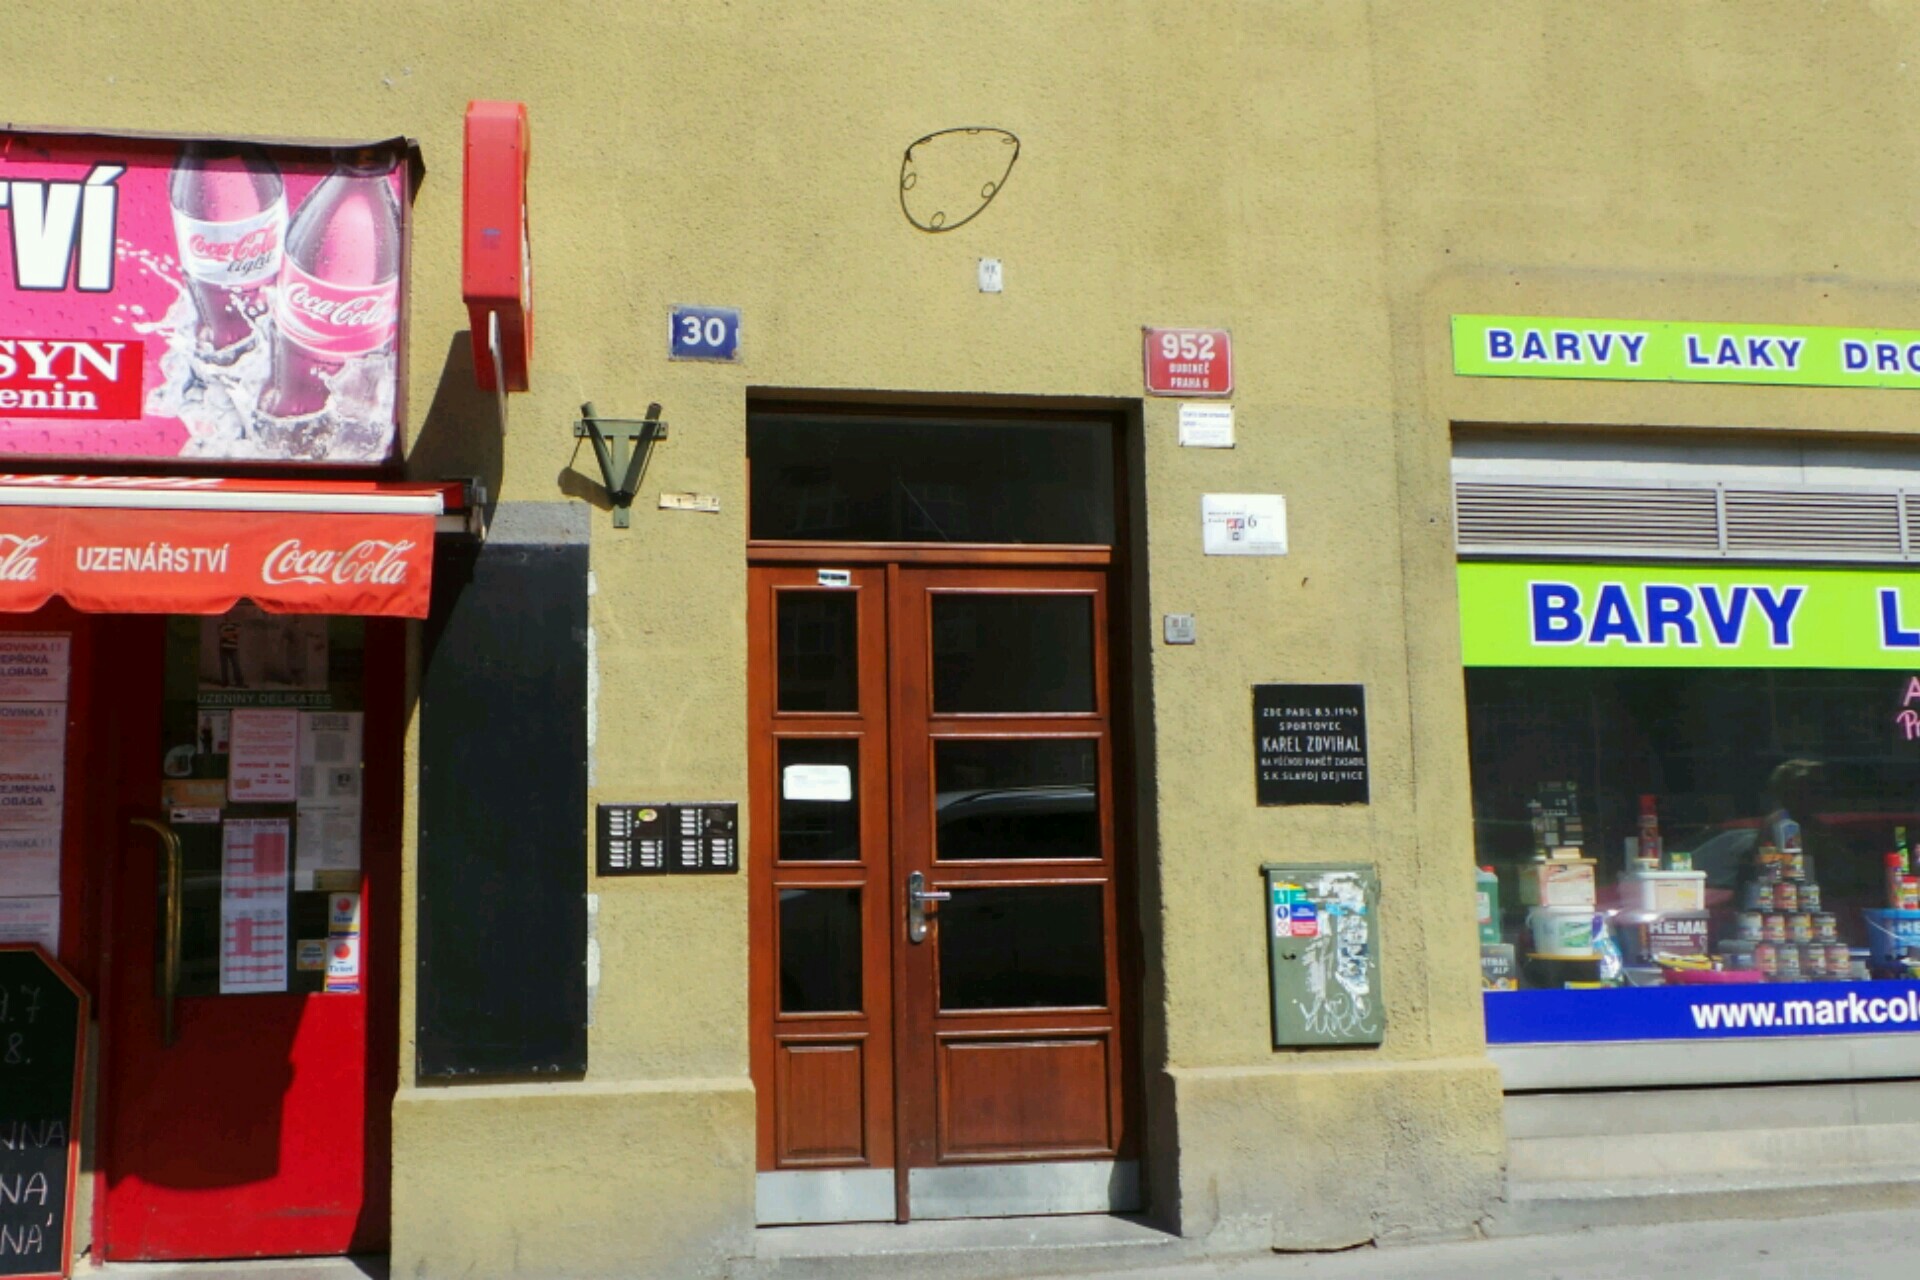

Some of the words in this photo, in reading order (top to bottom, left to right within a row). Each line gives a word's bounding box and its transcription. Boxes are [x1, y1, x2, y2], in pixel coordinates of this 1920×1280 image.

[0, 162, 125, 292] VÍ
[682, 316, 726, 347] 30
[1161, 333, 1215, 361] 952
[1488, 330, 1645, 363] BARVY
[1687, 336, 1801, 368] LAKY
[1170, 377, 1200, 388] PRAHA
[1203, 377, 1210, 389] 6
[0, 534, 48, 581] la
[76, 543, 229, 573] UZENÁŘSTVÍ
[262, 538, 417, 586] Coca-Cola
[1529, 582, 1805, 646] BARVY
[1279, 721, 1342, 731] SPORTOVEC
[1262, 735, 1302, 753] KAREL
[1691, 991, 1920, 1029] www.markcol
